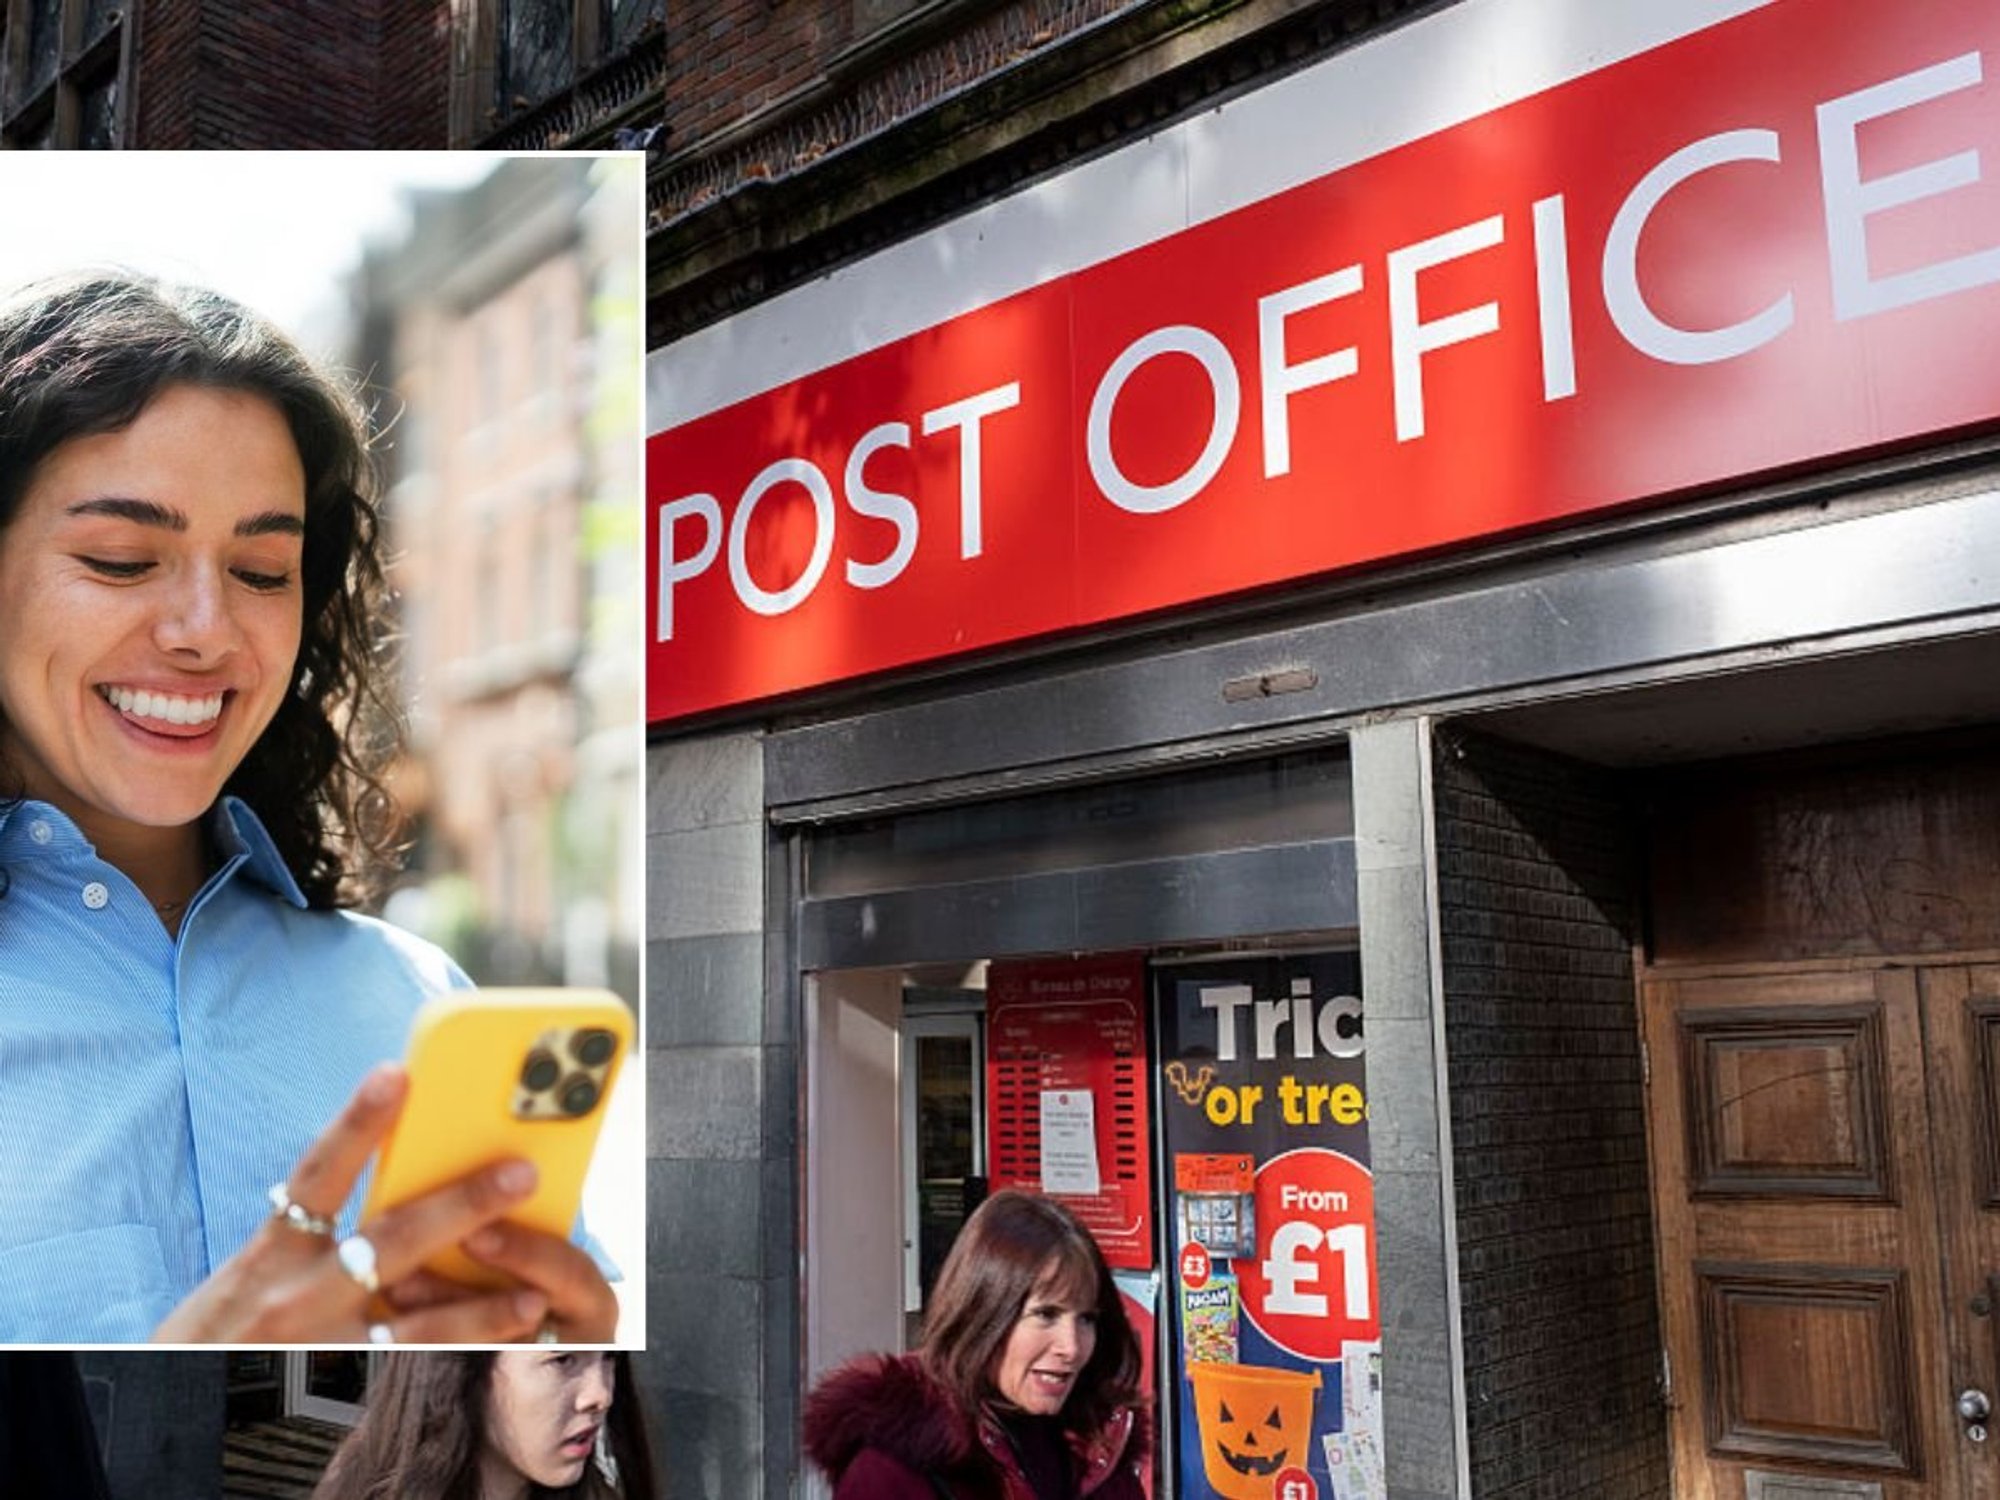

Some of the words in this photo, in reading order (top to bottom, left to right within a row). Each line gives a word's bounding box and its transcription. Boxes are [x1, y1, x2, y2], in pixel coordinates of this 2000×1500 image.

[657, 381, 1021, 643] POST
[1086, 50, 2000, 514] OFFICE
[1205, 1086, 1263, 1126] or
[1278, 1075, 1371, 1125] tre
[1280, 1184, 1349, 1213] From
[1183, 1254, 1206, 1278] £3
[1261, 1220, 1371, 1321] £1
[1282, 1480, 1308, 1500] £1
